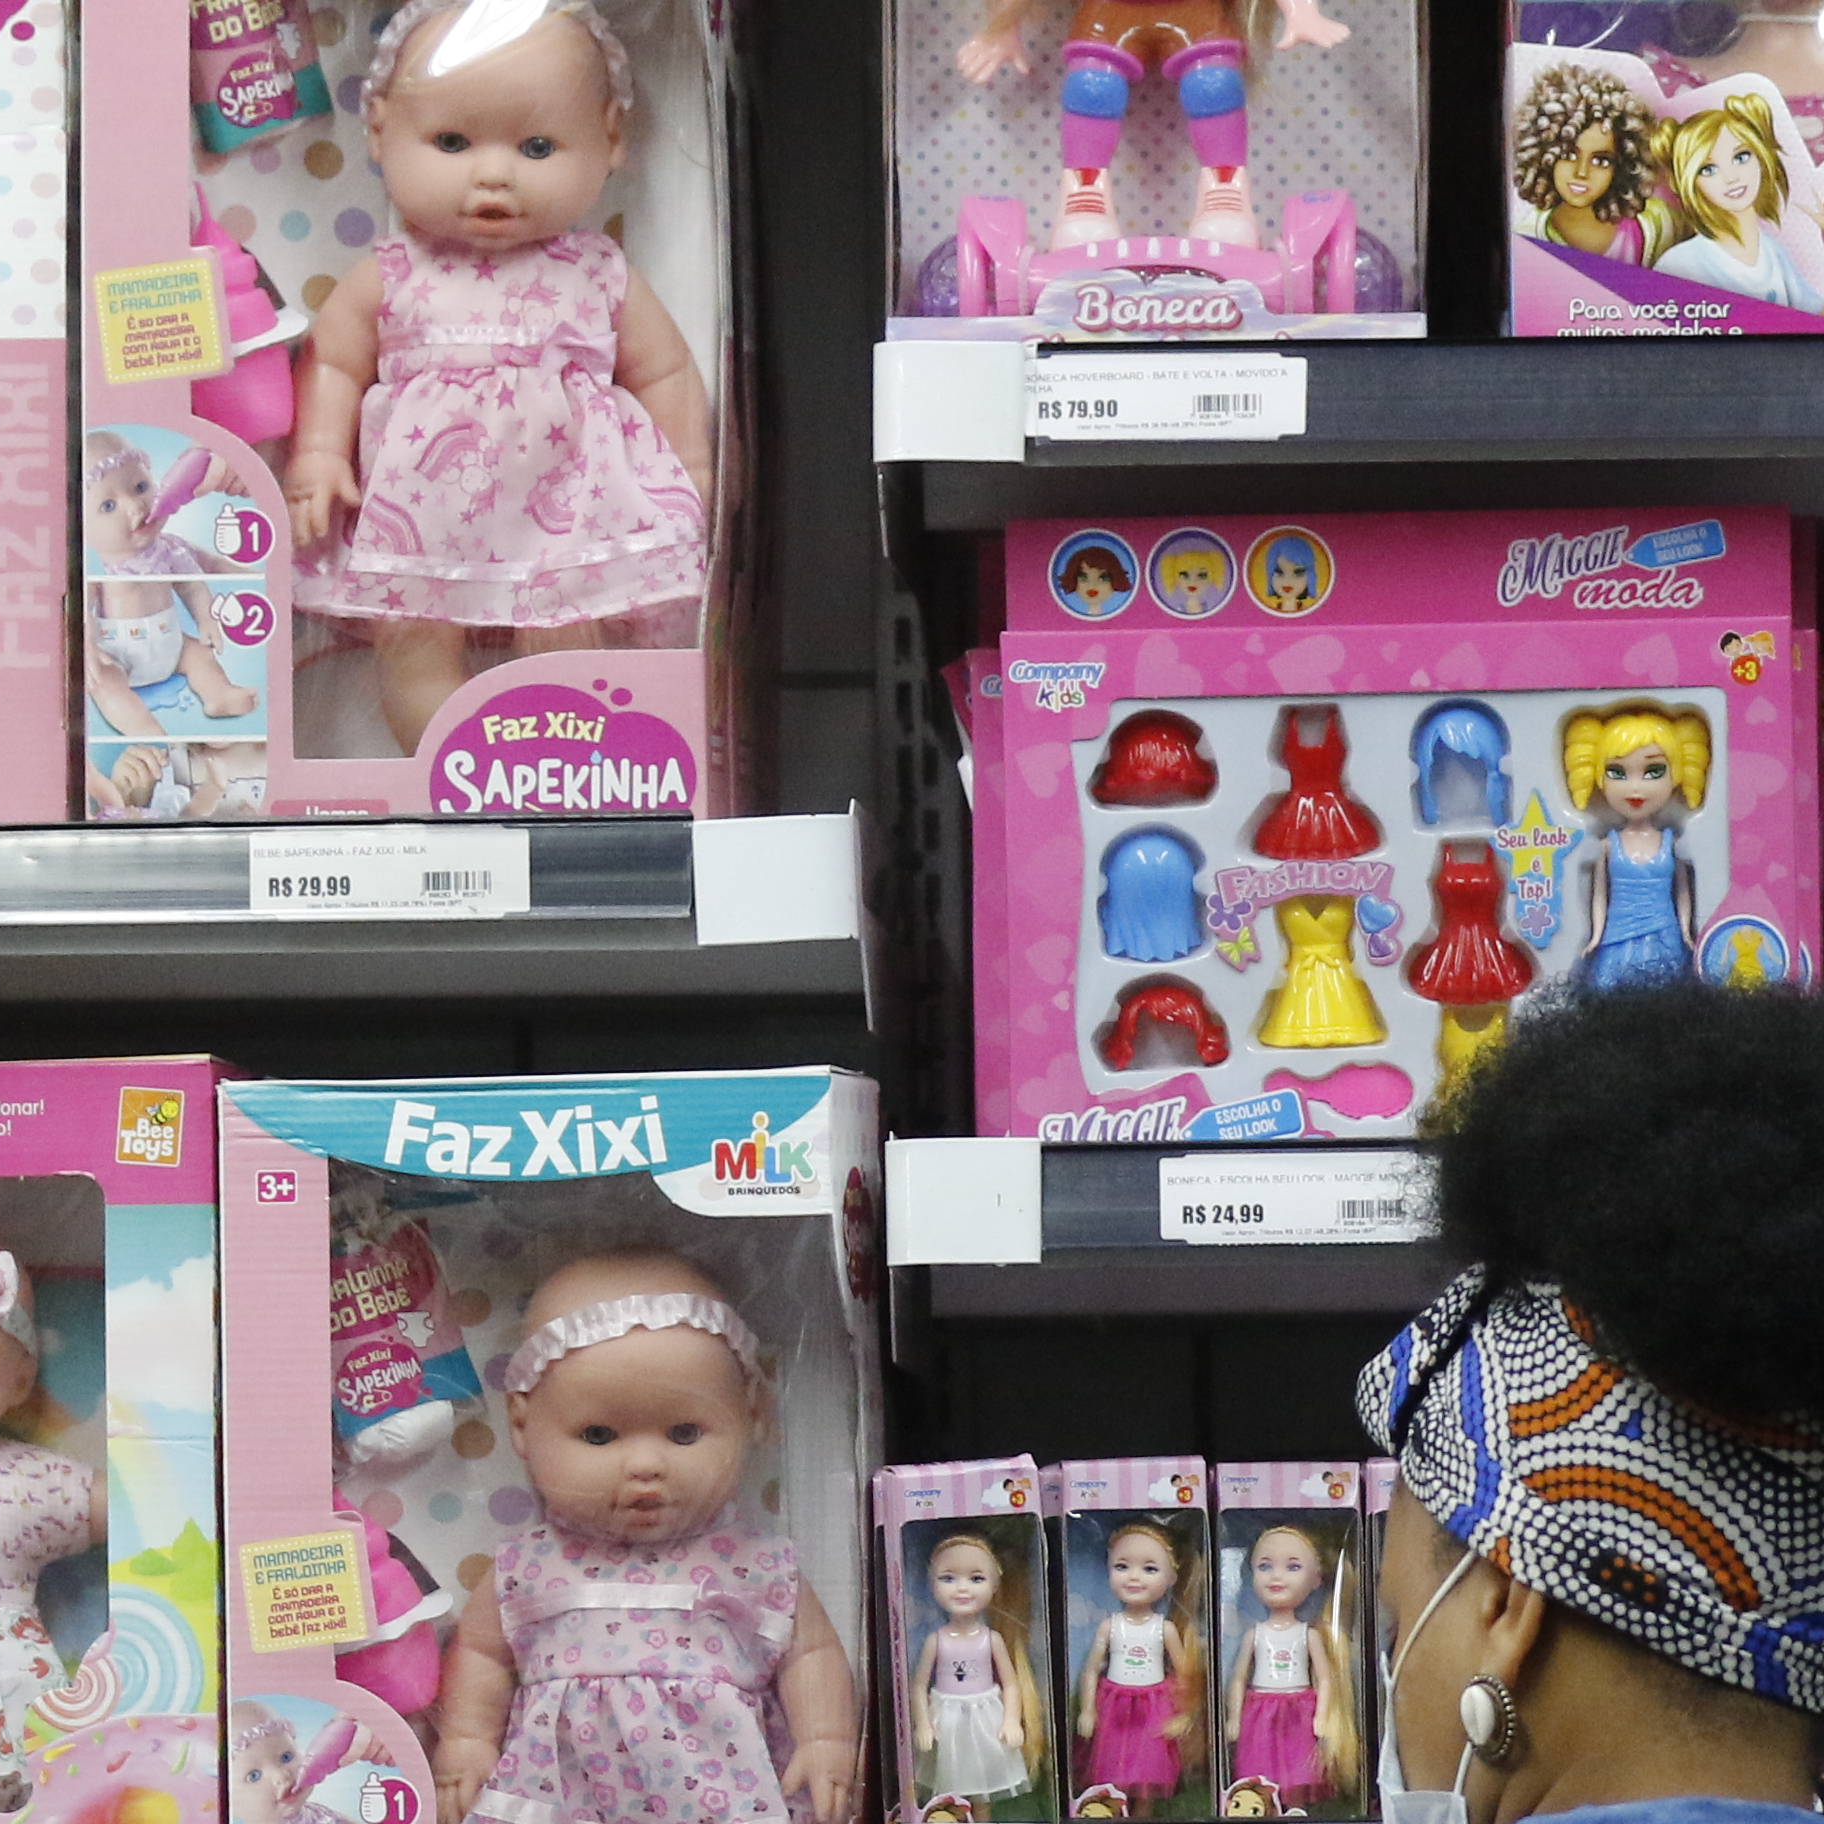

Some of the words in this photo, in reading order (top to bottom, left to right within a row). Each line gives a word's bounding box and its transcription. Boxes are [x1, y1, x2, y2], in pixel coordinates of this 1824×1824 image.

[1076, 284, 1242, 331] Boneca
[1569, 299, 1622, 320] Para
[1628, 300, 1679, 319] você
[1683, 300, 1731, 319] criar
[1039, 401, 1062, 419] R$
[1067, 400, 1118, 419] 79,90
[248, 520, 263, 552] 1
[1576, 568, 1702, 606] moda
[244, 605, 266, 637] 2
[1010, 661, 1105, 687] Company
[1733, 661, 1757, 681] +3
[482, 713, 539, 745] Faz
[543, 711, 607, 744] Xixi
[1497, 829, 1526, 850] Seu
[1530, 828, 1569, 848] look
[268, 877, 293, 897] R$
[298, 876, 351, 897] 29,99
[1217, 862, 1386, 906] FASHION
[1518, 878, 1551, 902] Top!
[1215, 1103, 1270, 1125] ESCOLHA
[1272, 1099, 1282, 1112] O
[137, 1118, 173, 1139] Bee
[383, 1099, 515, 1176] Faz
[519, 1096, 667, 1176] Xixi
[1220, 1124, 1243, 1140] SEU
[1245, 1118, 1277, 1137] LOOK
[121, 1130, 173, 1160] Toys
[260, 1175, 293, 1199] 3+
[728, 1185, 801, 1196] BRINQUEDOS
[1183, 1206, 1205, 1225] R$
[1212, 1204, 1263, 1224] 24,99
[253, 1543, 344, 1569] MAMADEIRA
[255, 1571, 265, 1585] E
[267, 1560, 347, 1584] FRALDINHA
[393, 1793, 405, 1820] 1
